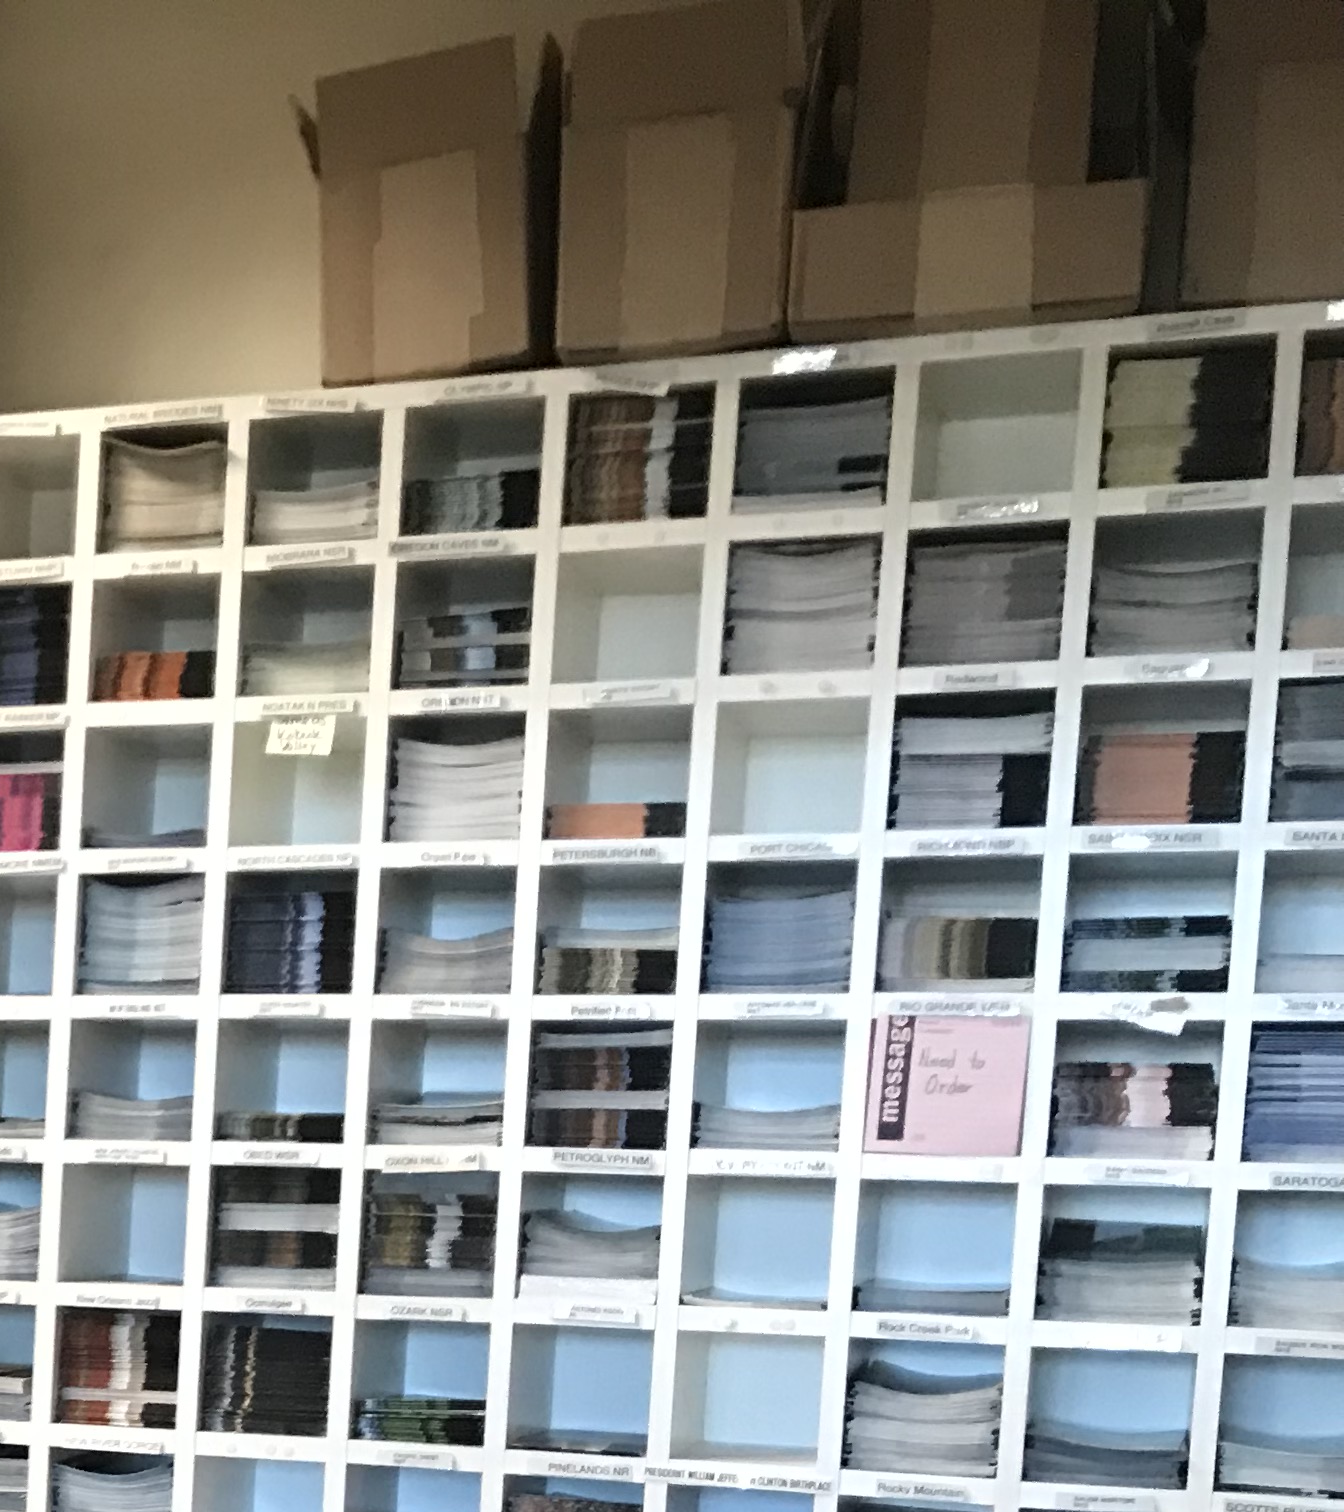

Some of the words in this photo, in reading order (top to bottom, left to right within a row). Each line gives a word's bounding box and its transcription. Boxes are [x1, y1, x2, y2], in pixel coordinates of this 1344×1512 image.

[1291, 829, 1337, 841] SANTA
[924, 1001, 977, 1012] GRANDE
[919, 1048, 957, 1070] Need
[969, 1050, 985, 1070] to
[883, 1016, 913, 1123] message
[924, 1073, 972, 1095] Order
[384, 1156, 418, 1167] OXON
[552, 1151, 630, 1164] PETROGLYPH
[631, 1153, 651, 1166] NM
[1272, 1175, 1344, 1188] SARATOGA
[390, 1305, 427, 1316] OZARK
[877, 1321, 907, 1333] Rock
[908, 1323, 941, 1335] Creek
[548, 1462, 611, 1476] PINELANDS
[612, 1465, 630, 1477] NR
[688, 1470, 715, 1481] WILLIAM
[757, 1476, 788, 1488] CLINTON
[789, 1478, 832, 1492] BIRTHPLACE
[877, 1482, 911, 1495] Rocky
[913, 1484, 965, 1497] Mountain
